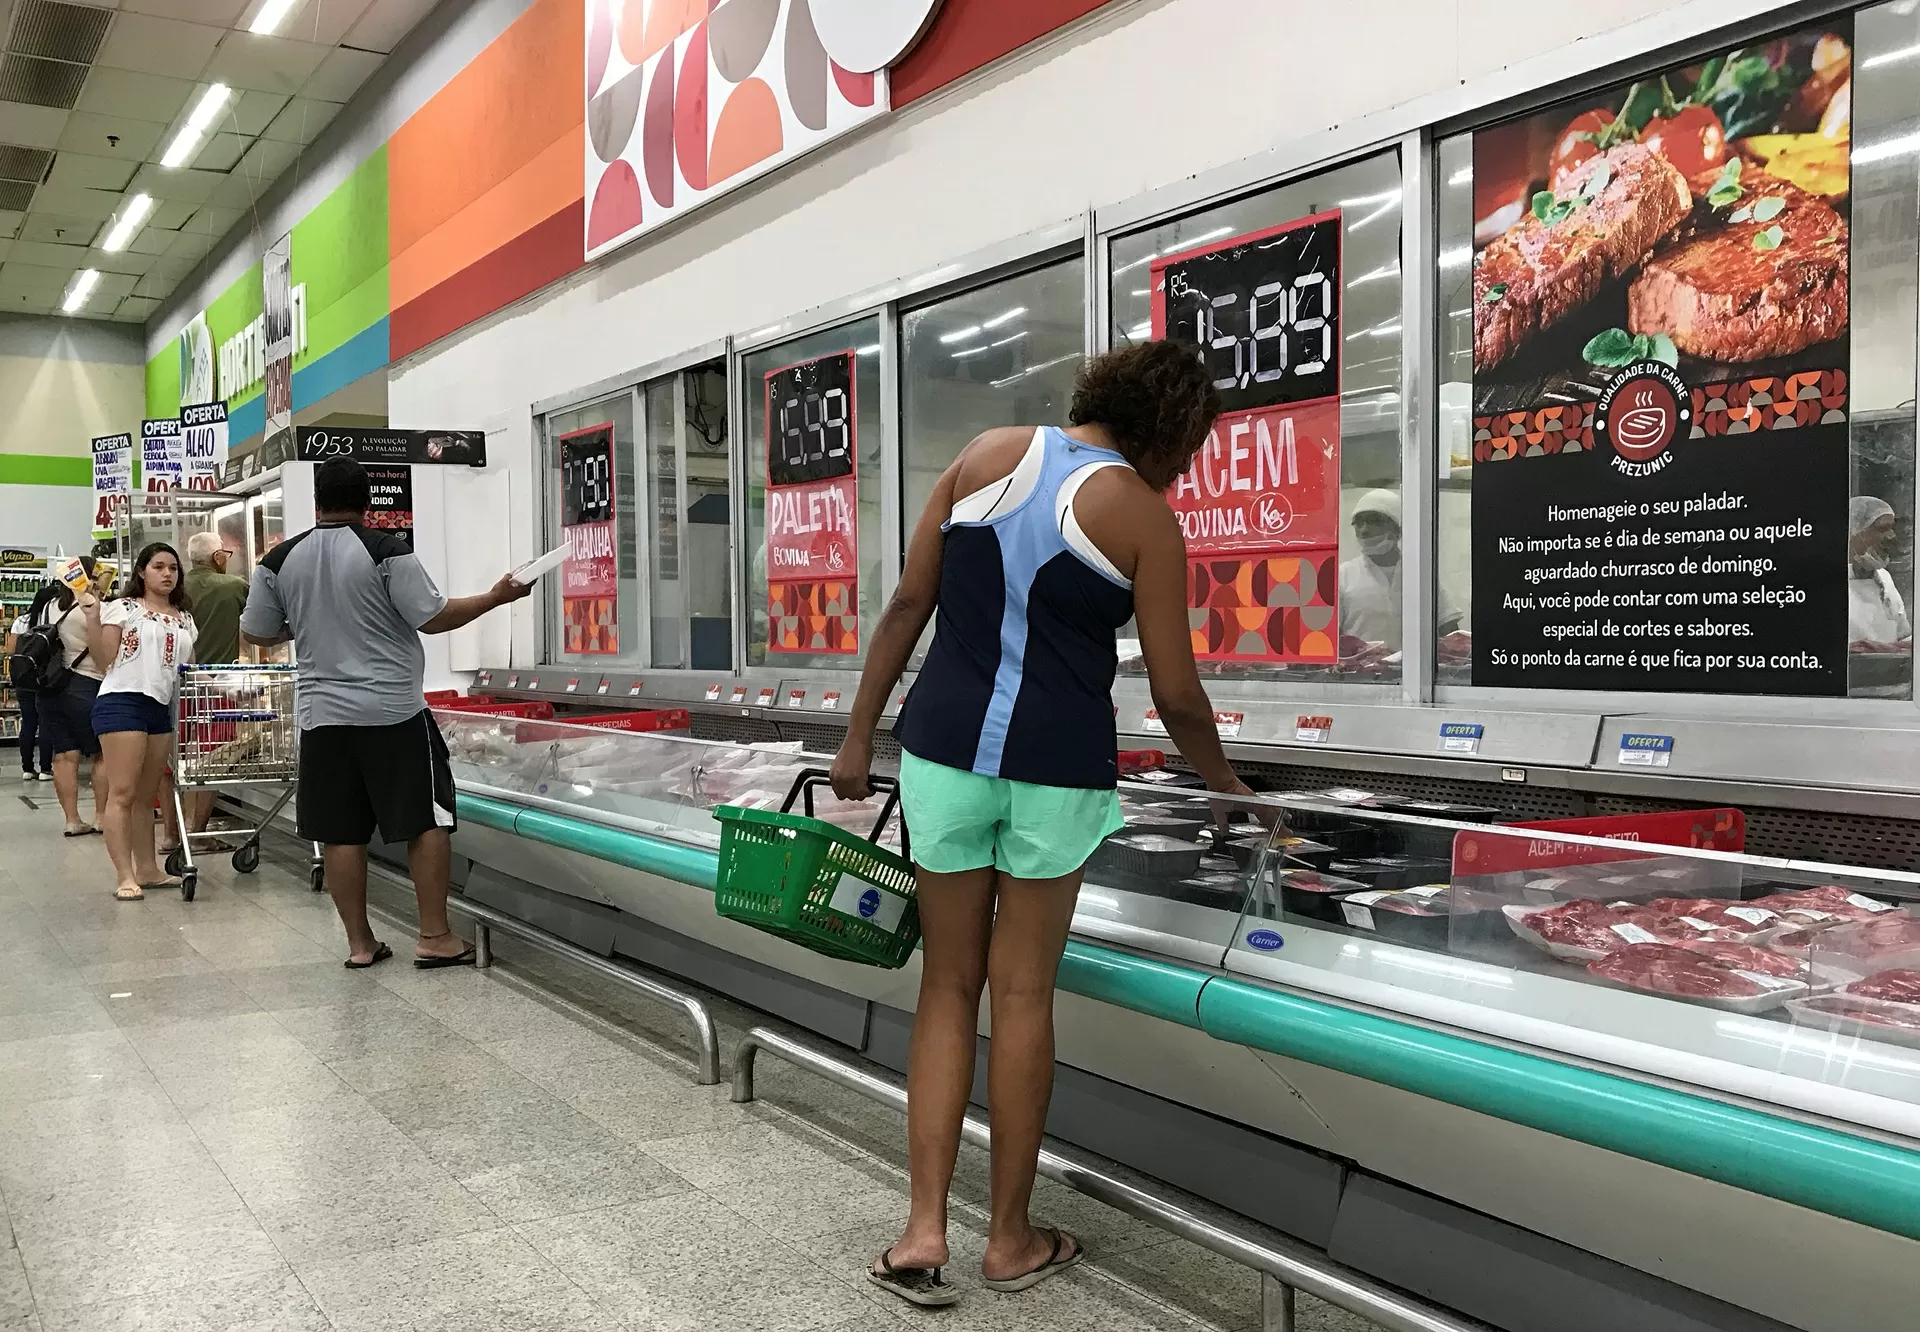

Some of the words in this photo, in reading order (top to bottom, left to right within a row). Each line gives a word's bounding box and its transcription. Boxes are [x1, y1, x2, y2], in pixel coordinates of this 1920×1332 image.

[1170, 270, 1188, 297] R$
[1197, 272, 1331, 389] 15,89
[1598, 363, 1644, 411] QUALIDADE
[1646, 363, 1660, 375] DA
[1660, 367, 1688, 401] CARNE
[184, 404, 226, 425] OFERTA
[144, 420, 181, 436] OFERT
[95, 435, 130, 451] OFERTA
[185, 427, 215, 458] ALHO
[305, 431, 354, 456] 1953
[369, 437, 407, 446] EVOLUÇÃO
[375, 445, 407, 453] PALADAR
[387, 470, 407, 479] hora!
[1610, 451, 1673, 477] PREZUNIC
[380, 485, 403, 494] PARA
[771, 484, 852, 536] PALETA
[1174, 505, 1248, 539] BOVINA
[1260, 499, 1285, 530] Kg
[1548, 500, 1636, 522] Homenageie
[1641, 504, 1649, 515] o
[1653, 501, 1679, 514] seu
[1684, 491, 1748, 517] paladar.
[564, 526, 613, 561] PICANHA
[1499, 536, 1524, 554] Não
[1528, 534, 1581, 555] importa
[1585, 537, 1600, 548] se
[1604, 531, 1612, 547] é
[1617, 529, 1638, 547] dia
[1642, 528, 1661, 545] de
[1664, 529, 1725, 544] semana
[1729, 528, 1750, 541] ou
[1754, 518, 1813, 543] aquele
[3, 551, 34, 563] Vapza
[773, 546, 810, 567] BOVINA
[829, 543, 844, 569] Kg
[1525, 561, 1597, 584] aguardado
[1601, 560, 1674, 577] churrasco
[1679, 556, 1698, 574] de
[1702, 554, 1777, 576] domingo.
[1502, 592, 1536, 613] Aqui,
[1539, 591, 1571, 608] você
[1575, 590, 1609, 612] pode
[1613, 590, 1661, 606] contar
[1665, 593, 1698, 605] com
[1702, 592, 1738, 605] uma
[1742, 585, 1806, 609] seleção
[1543, 618, 1598, 641] especial
[1602, 618, 1620, 637] de
[1624, 620, 1671, 637] cortes
[1674, 624, 1684, 637] e
[1687, 618, 1754, 637] sabores.
[1492, 649, 1507, 664] Só
[1511, 654, 1518, 664] o
[1522, 649, 1561, 670] ponto
[1564, 649, 1581, 666] da
[1585, 655, 1624, 666] carne
[1628, 650, 1637, 666] é
[1641, 655, 1669, 671] que
[1673, 648, 1702, 668] fica
[1706, 655, 1734, 673] por
[1737, 655, 1766, 669] sua
[1770, 651, 1823, 669] conta.
[1445, 726, 1475, 736] OFERTA
[1627, 736, 1665, 748] OFERTA
